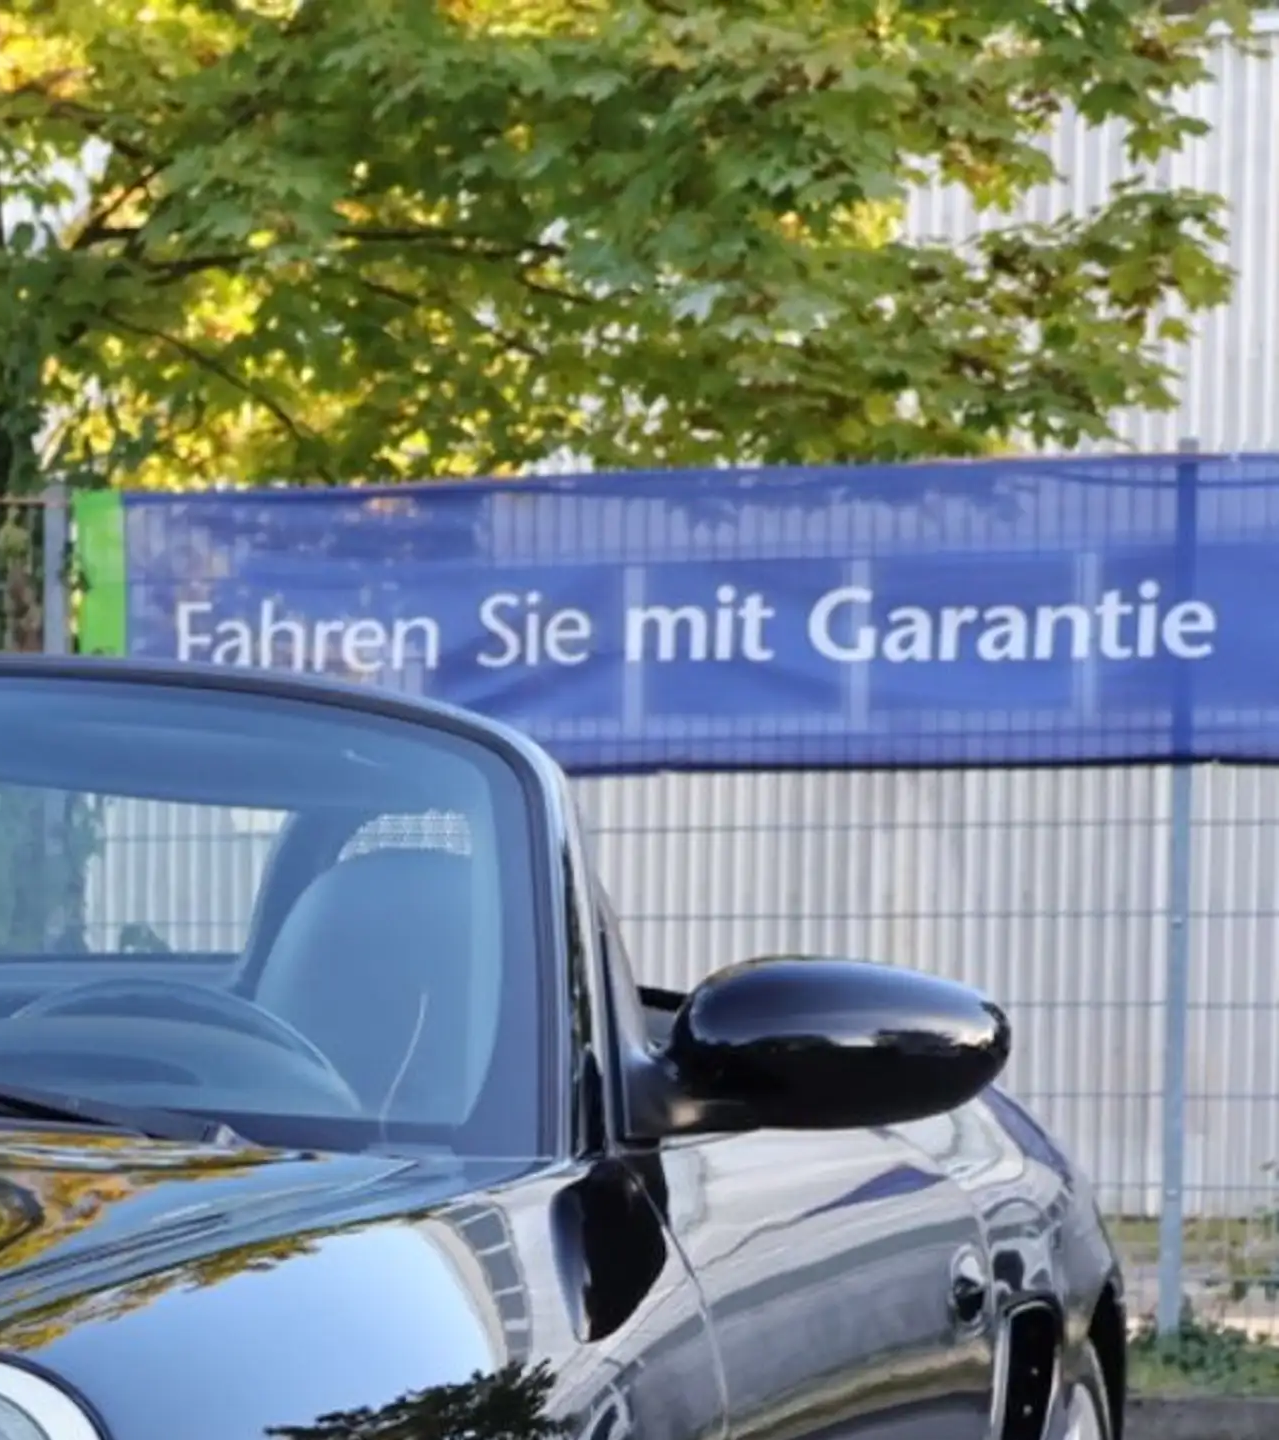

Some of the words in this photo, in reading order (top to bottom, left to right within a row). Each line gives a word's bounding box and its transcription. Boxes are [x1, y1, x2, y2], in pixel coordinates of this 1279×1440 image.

[175, 599, 440, 673] Fahren
[476, 590, 591, 669] Sie
[625, 584, 776, 663] mit
[807, 579, 1217, 663] Garantie
